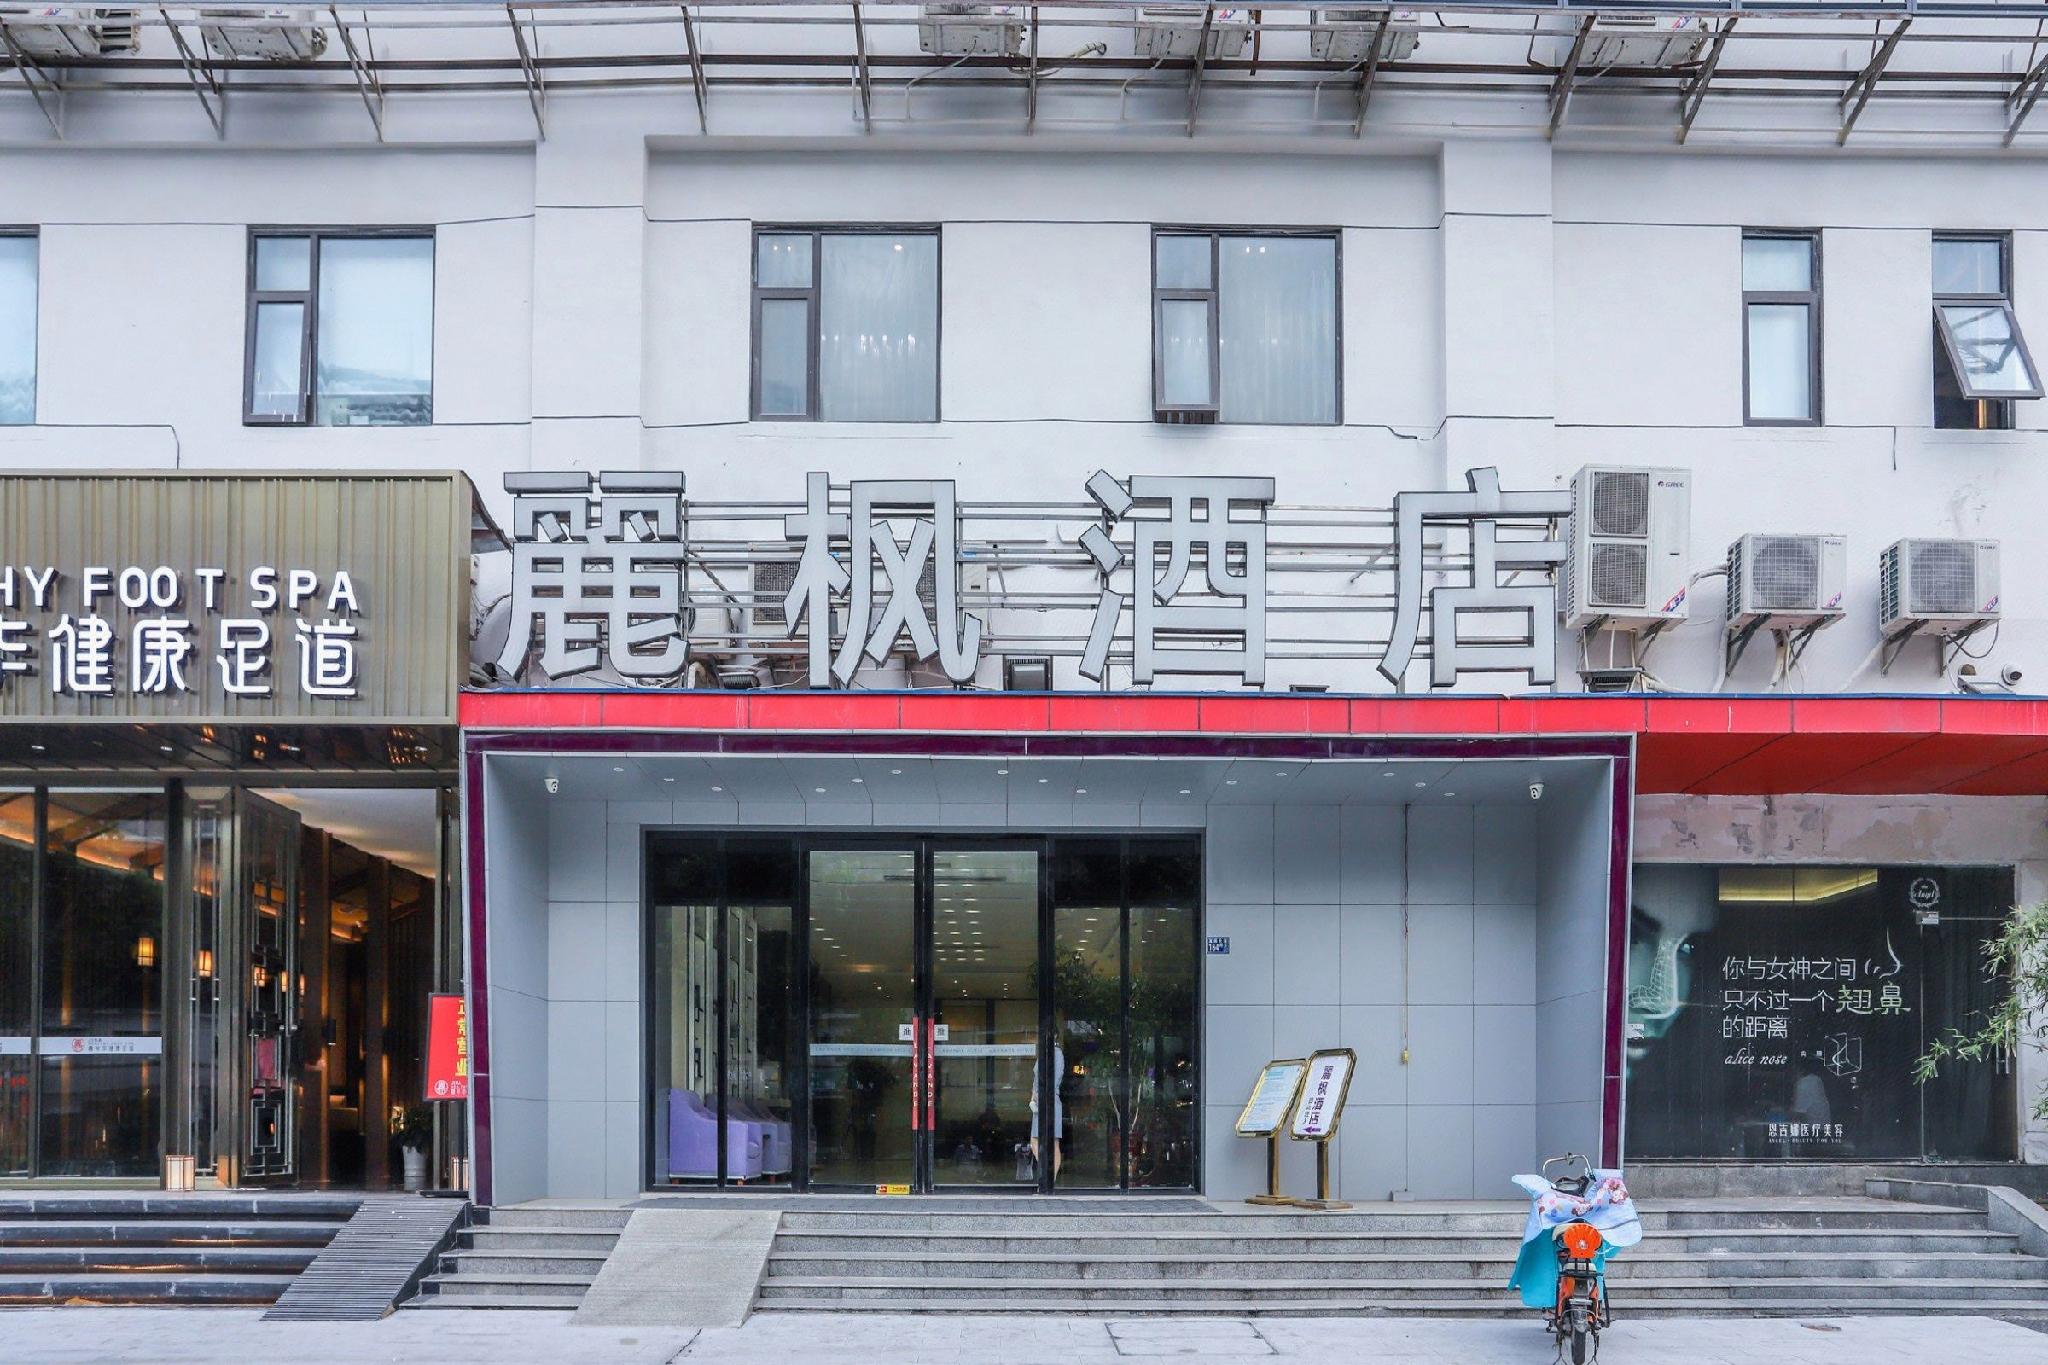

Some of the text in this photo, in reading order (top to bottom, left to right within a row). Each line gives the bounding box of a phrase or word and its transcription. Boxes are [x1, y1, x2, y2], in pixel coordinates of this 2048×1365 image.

[250, 567, 359, 612] SPA
[497, 466, 1572, 689] 麗枫酒店
[1722, 955, 1857, 981] 你与女神之间
[1722, 1015, 1790, 1039] 的距离
[1724, 1047, 1788, 1065] alice nose
